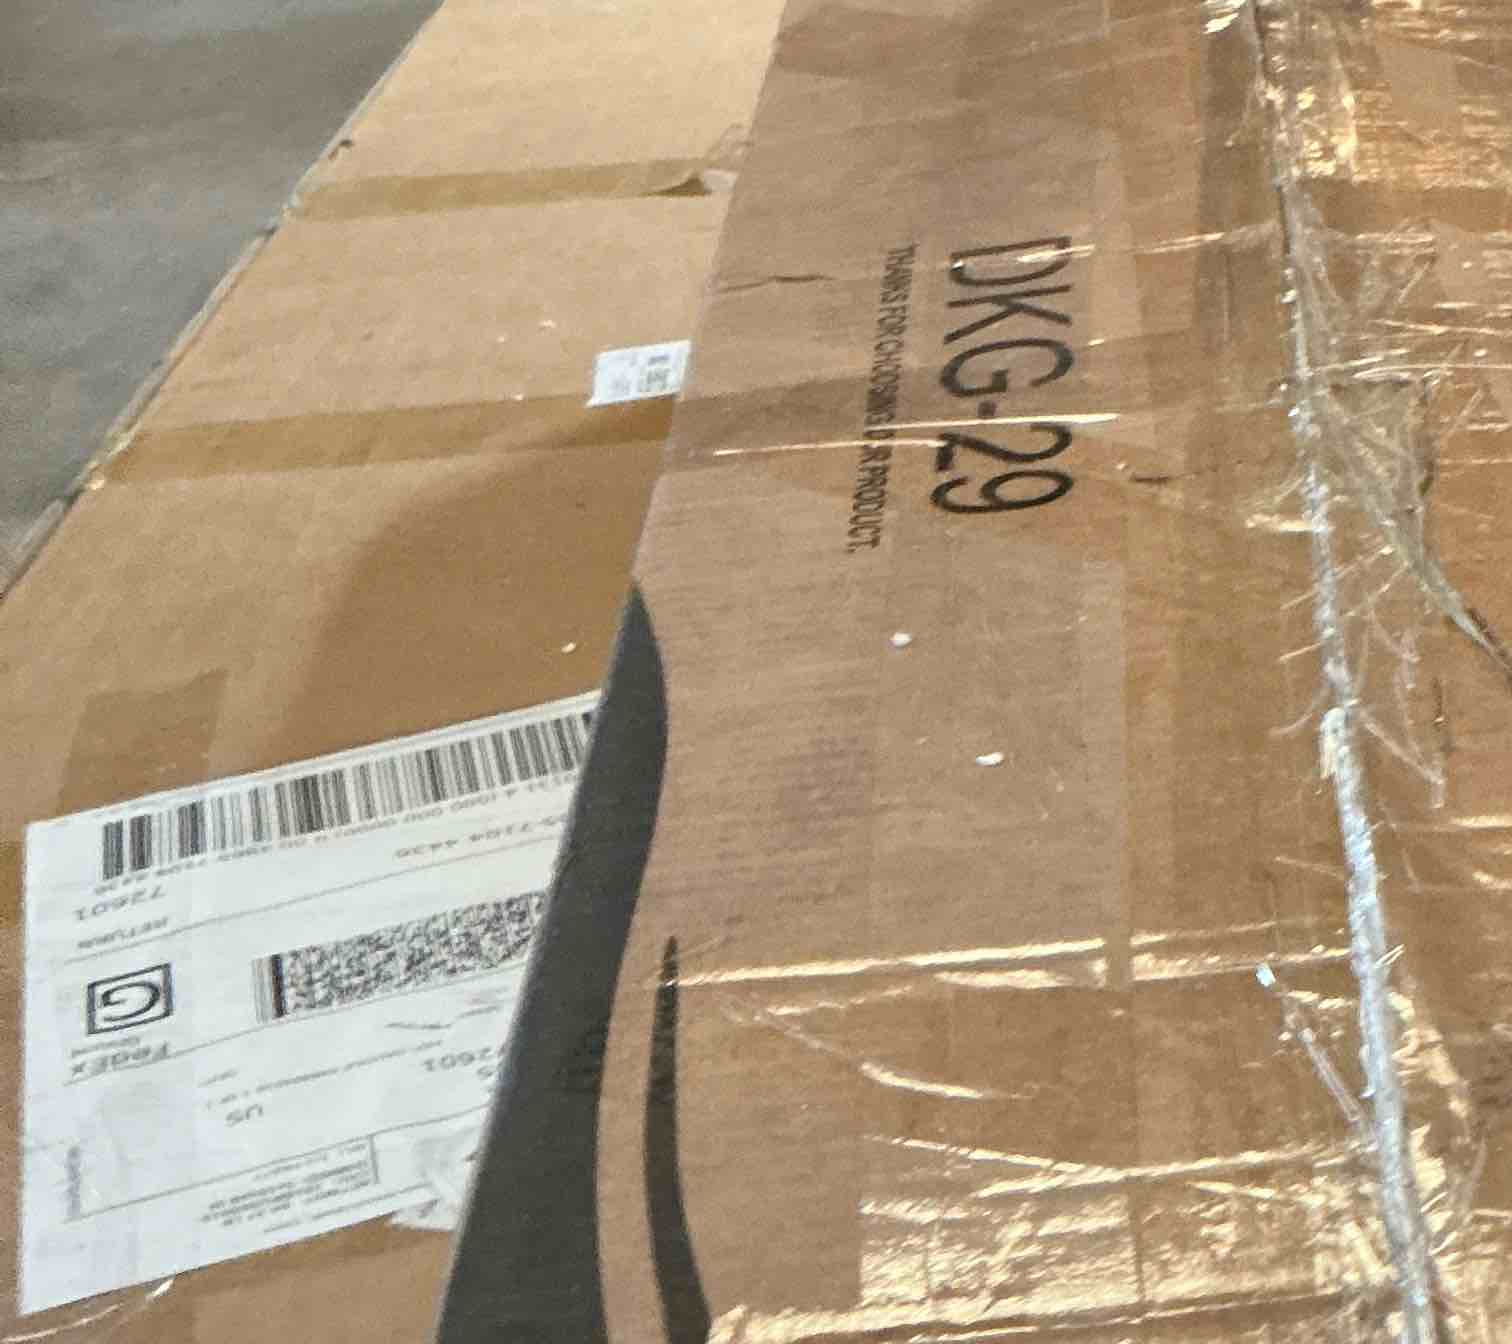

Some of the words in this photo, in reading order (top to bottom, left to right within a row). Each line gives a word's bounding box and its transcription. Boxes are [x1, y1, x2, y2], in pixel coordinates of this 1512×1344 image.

[880, 243, 918, 305] THANKS
[876, 305, 906, 337] FOR
[864, 338, 902, 427] CHOOSING
[931, 236, 1075, 514] DKG-29
[846, 464, 887, 553] PRODUCT.
[100, 981, 162, 1023] G
